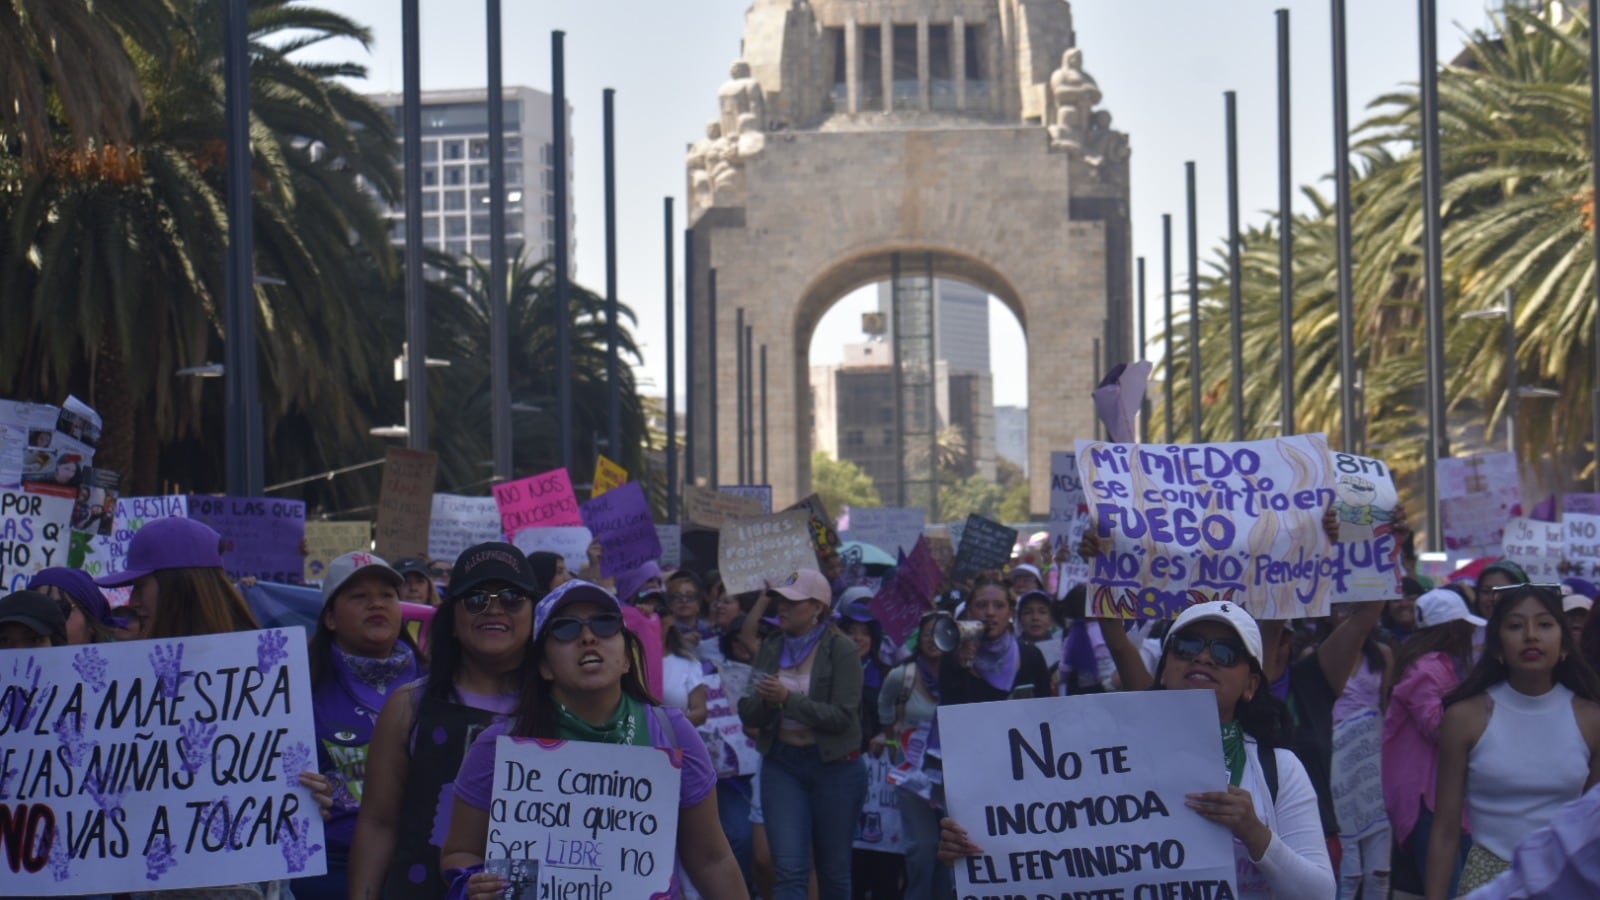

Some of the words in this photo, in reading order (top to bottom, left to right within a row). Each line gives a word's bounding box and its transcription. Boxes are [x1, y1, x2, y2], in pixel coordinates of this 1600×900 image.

[1335, 453, 1384, 477] 8M
[2, 493, 42, 516] POR
[498, 486, 521, 506] NO
[528, 475, 565, 499] NOS
[1092, 480, 1129, 499] se
[1293, 487, 1336, 511] en
[133, 497, 183, 518] BESTIA
[189, 500, 224, 515] POR
[232, 501, 266, 516] LAS
[272, 502, 303, 518] QUE
[501, 496, 577, 532] CONOCEMOS
[0, 517, 34, 543] AS
[737, 519, 792, 541] LIBRES
[1095, 503, 1236, 551] FUEGO
[1569, 522, 1597, 539] NO
[0, 541, 31, 567] HO
[42, 546, 56, 567] Y
[1150, 555, 1187, 580] es
[0, 684, 37, 736] OY
[34, 682, 83, 736] LA
[95, 665, 292, 730] MAESTRA
[0, 749, 17, 800] E
[16, 745, 73, 799] LAS
[79, 731, 194, 795] NIÑAS
[212, 728, 289, 786] QUE
[1091, 745, 1131, 775] TE
[502, 760, 544, 792] De
[491, 798, 506, 823] a
[514, 799, 571, 828] casa
[583, 806, 658, 840] quiero
[985, 790, 1170, 836] INCOMODA
[0, 802, 56, 874] NO
[66, 807, 129, 859] VAS
[143, 805, 172, 856] A
[185, 793, 299, 854] TOCAR
[544, 832, 605, 867] LIBRE
[621, 847, 654, 877] no
[966, 855, 1008, 884] EL
[1008, 839, 1185, 882] FEMINISMO
